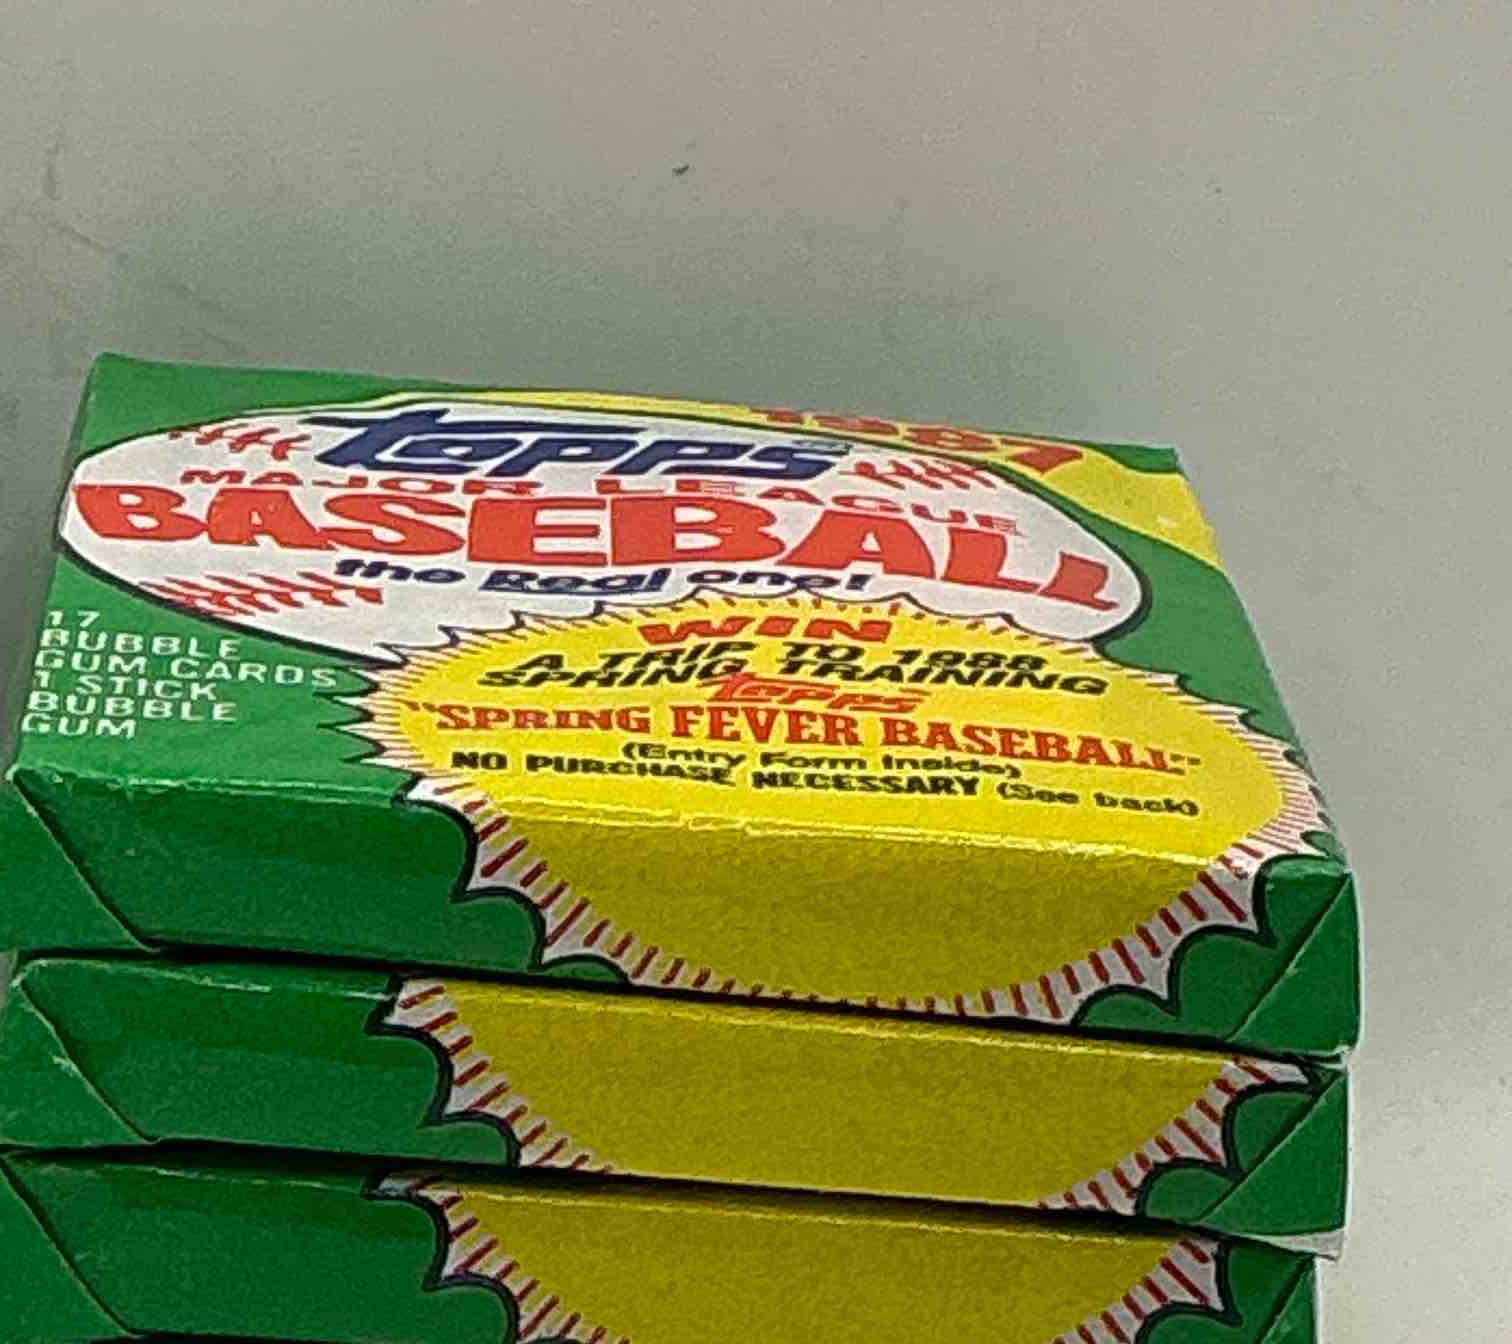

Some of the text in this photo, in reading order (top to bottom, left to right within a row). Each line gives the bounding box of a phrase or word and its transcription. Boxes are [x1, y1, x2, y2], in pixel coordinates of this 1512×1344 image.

[179, 468, 1020, 536] MAJOR LEAGUE
[72, 484, 1120, 611] BASEBALL
[333, 559, 872, 594] the Real one!
[45, 610, 100, 628] 17
[638, 616, 893, 645] WIN
[40, 628, 241, 660] BUBBLE
[511, 654, 566, 672] A
[782, 642, 864, 662] TO
[34, 650, 339, 688] GUM CARDS
[779, 659, 1109, 696] TRAINING
[75, 674, 218, 702] STICK
[28, 691, 238, 722] BUBBLE
[21, 712, 137, 739] GUM
[669, 704, 860, 746] FEVER
[451, 750, 509, 771] NO
[525, 752, 736, 786] PURCHASE
[750, 768, 981, 797] NECESSARY
